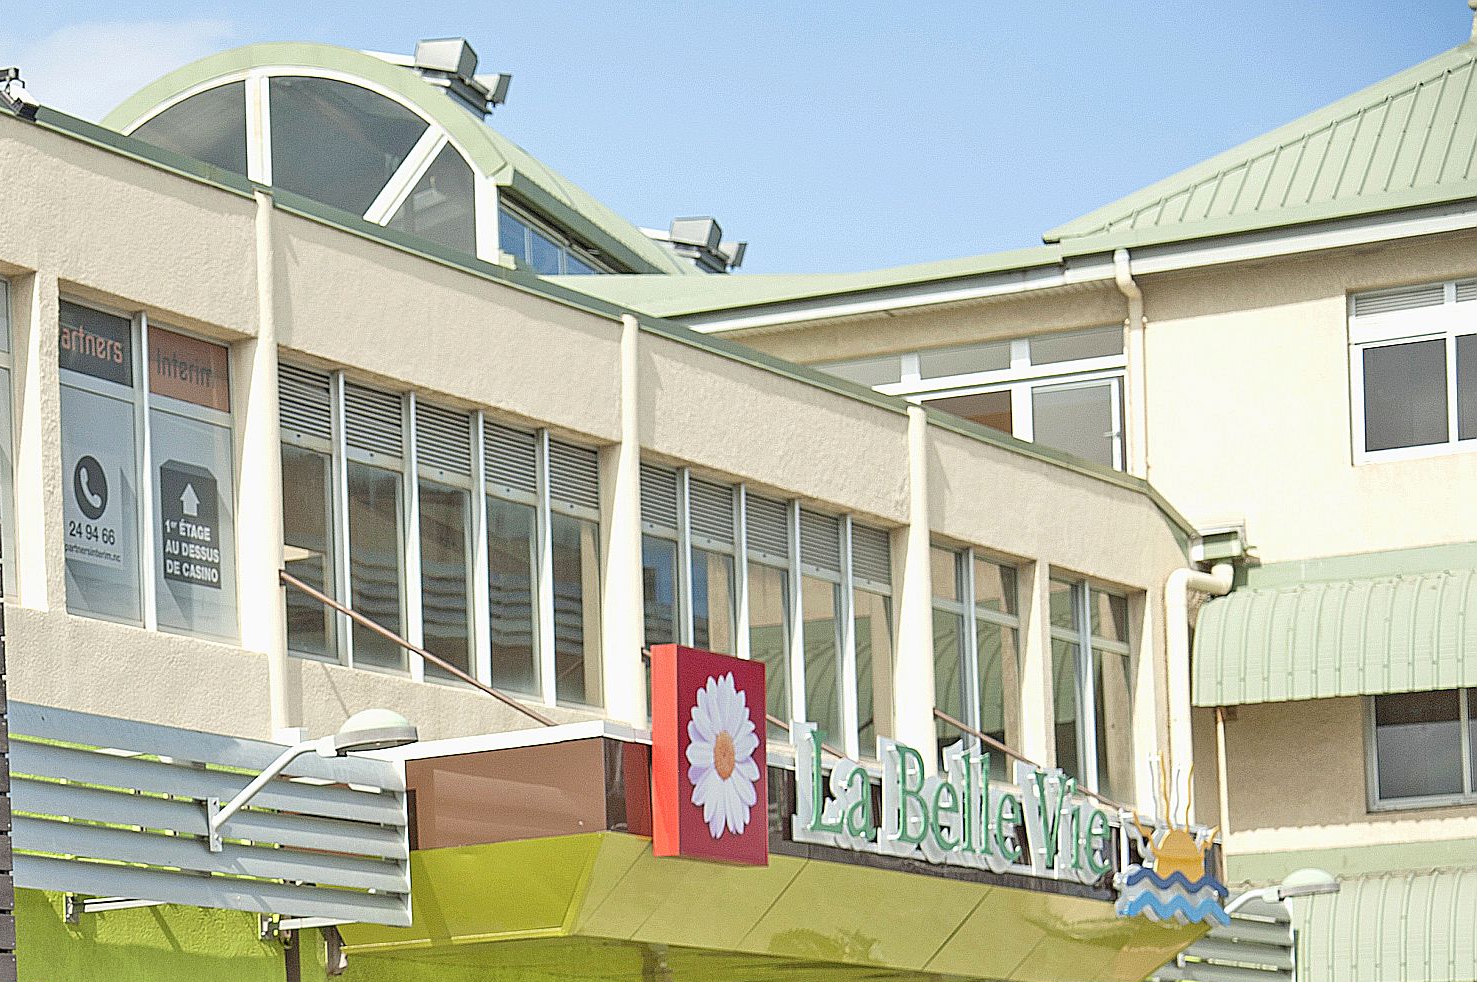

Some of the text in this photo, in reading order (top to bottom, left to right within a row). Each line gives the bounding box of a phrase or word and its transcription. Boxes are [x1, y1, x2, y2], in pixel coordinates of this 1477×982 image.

[61, 325, 123, 364] artners
[69, 521, 115, 545] 24 94 66
[180, 519, 211, 541] ÉTAGE
[165, 539, 220, 563] AU DESSUS
[166, 559, 219, 582] DE CASINO
[808, 729, 1112, 876] La Belle Vie
